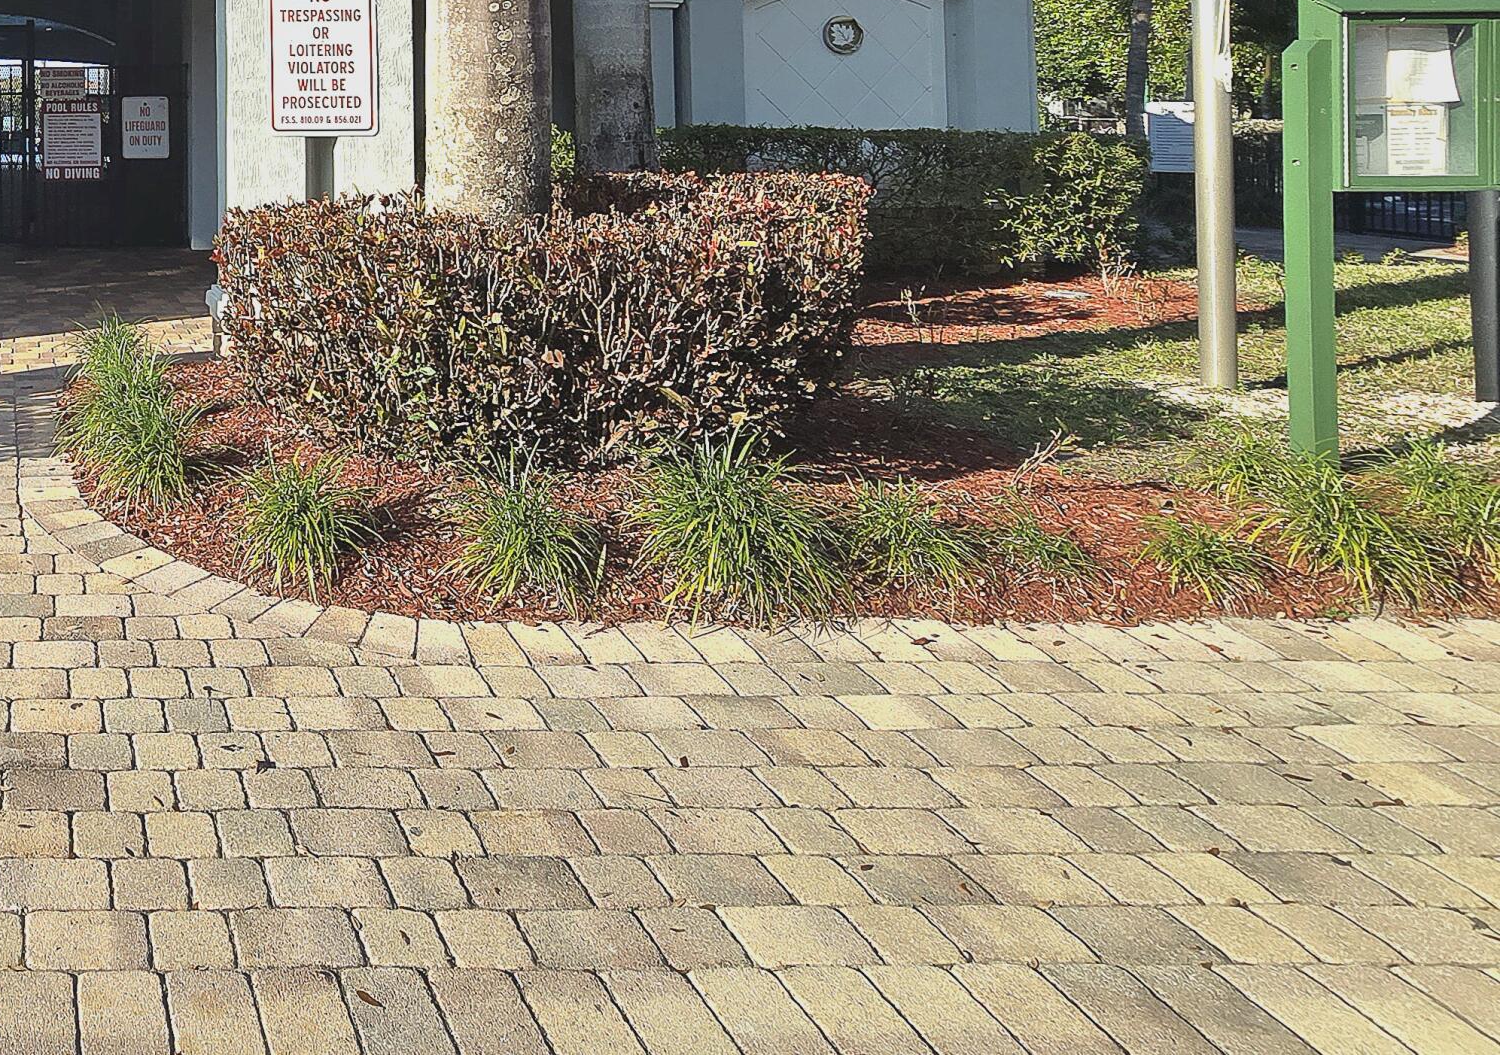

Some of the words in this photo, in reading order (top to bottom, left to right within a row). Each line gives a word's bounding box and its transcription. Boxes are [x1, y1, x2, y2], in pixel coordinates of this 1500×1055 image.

[280, 9, 361, 22] TRESPASSING
[312, 26, 329, 39] OR
[289, 44, 353, 57] LOITERING
[288, 61, 355, 74] VIOLATORS
[297, 78, 327, 91] WILL
[332, 78, 346, 91] BE
[46, 102, 68, 112] POOL
[71, 102, 98, 112] RULES
[282, 96, 361, 109] PROSECUTED
[139, 106, 151, 117] NO
[300, 116, 323, 124] 810.09
[326, 116, 331, 124] &
[334, 116, 361, 124] 856.021
[125, 121, 166, 132] LIFEGUARD
[129, 135, 140, 146] ON
[142, 135, 162, 146] DUTY
[46, 168, 60, 179] NO
[64, 167, 100, 179] DIVING
